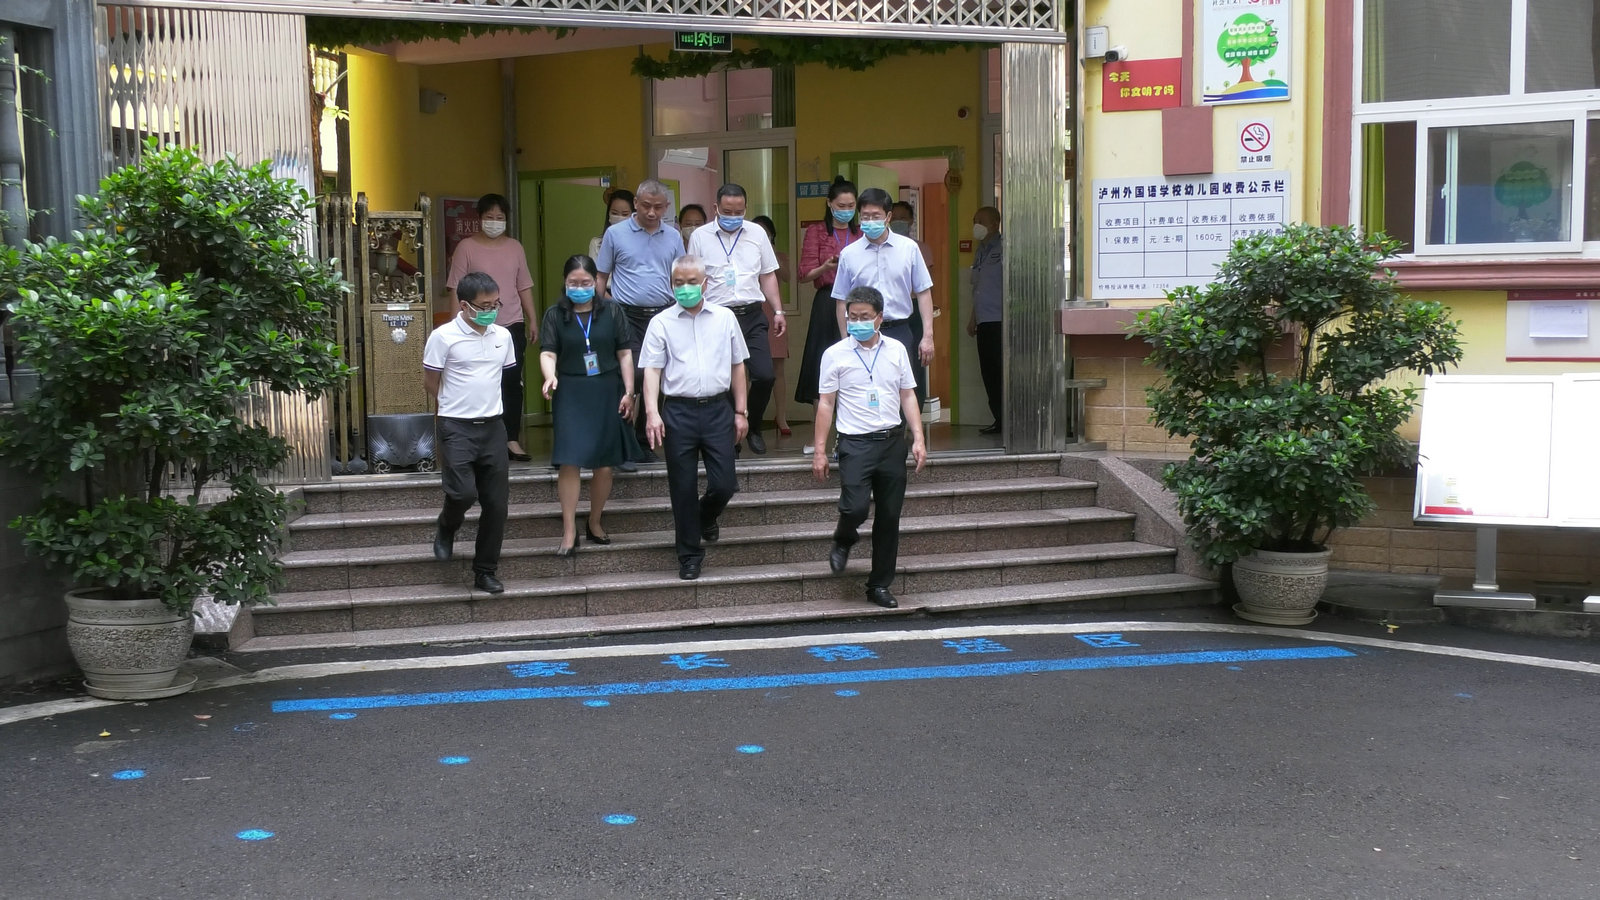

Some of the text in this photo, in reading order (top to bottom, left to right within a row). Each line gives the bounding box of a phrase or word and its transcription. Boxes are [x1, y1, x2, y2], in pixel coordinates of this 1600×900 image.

[712, 35, 725, 44] EXIT
[1109, 71, 1130, 83] 今天
[1120, 84, 1175, 98] 你文明了吗
[1240, 154, 1272, 164] 禁止吸烟
[1098, 179, 1285, 200] 泸州外国语学校幼儿园收费公示栏
[1105, 217, 1139, 227] 收费项目
[1149, 216, 1184, 225] 计费单位
[1192, 214, 1227, 223] 收费标准
[1239, 212, 1275, 222] 收费依据
[1195, 232, 1222, 242] 1600元
